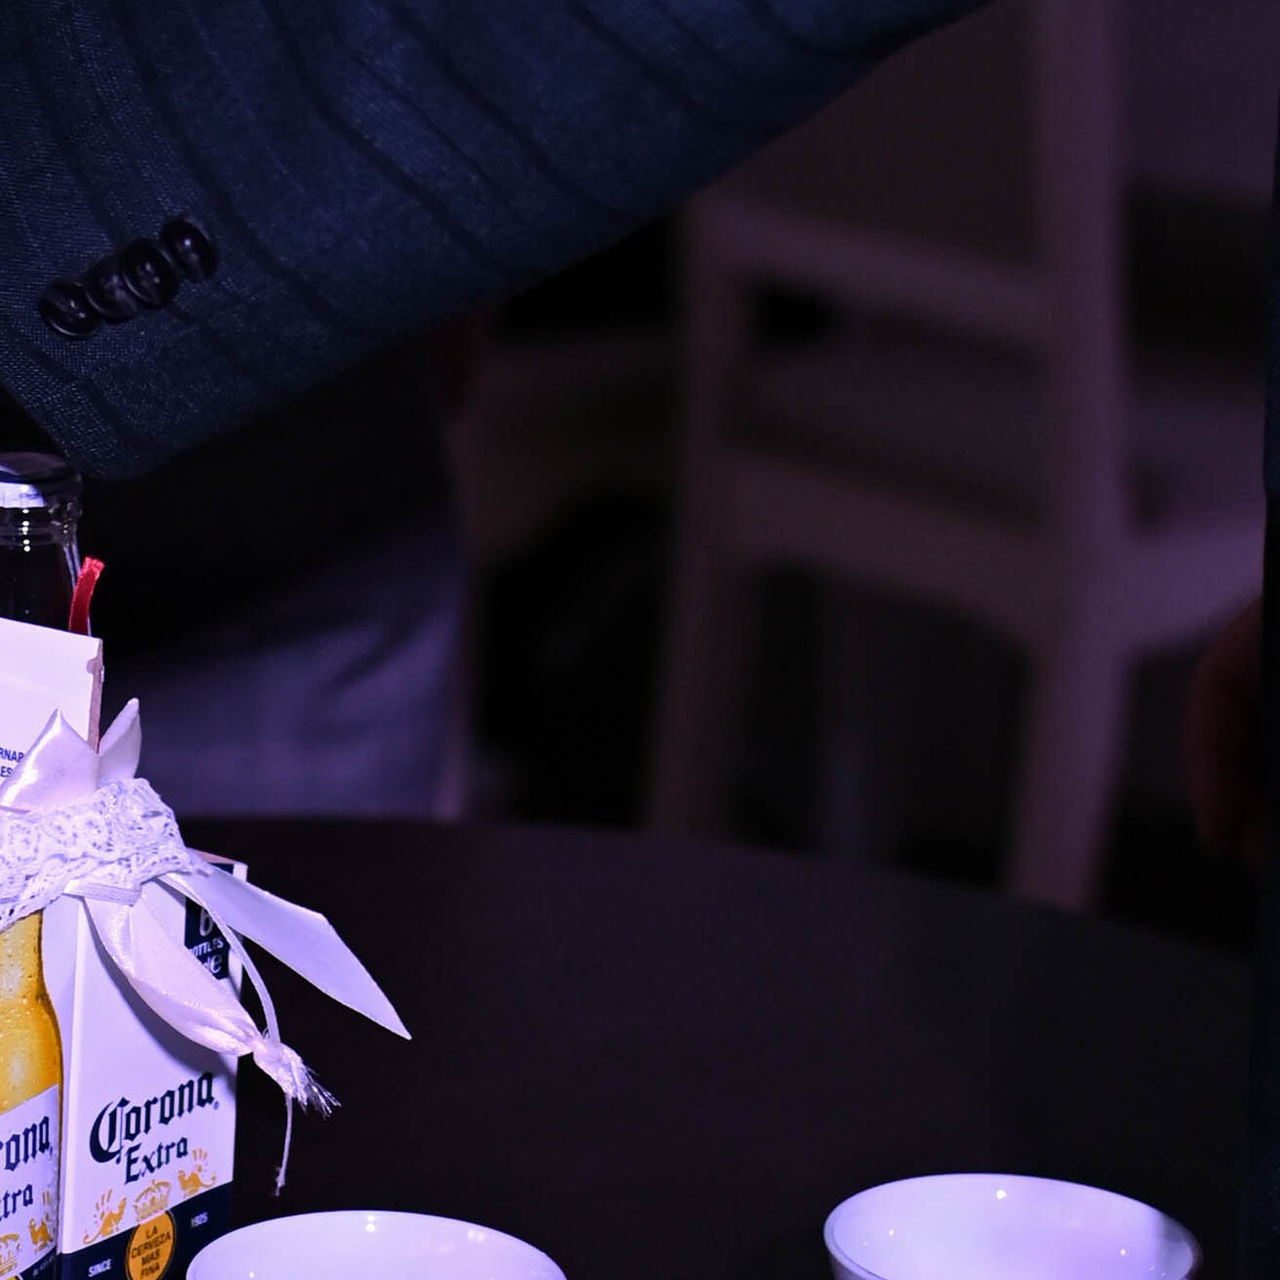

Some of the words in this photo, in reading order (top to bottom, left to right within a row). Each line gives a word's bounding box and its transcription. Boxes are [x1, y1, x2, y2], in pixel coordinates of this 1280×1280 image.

[89, 1072, 215, 1165] Corona
[125, 1137, 188, 1186] Extra
[146, 1225, 158, 1239] LA
[131, 1232, 171, 1259] CERVEZA
[88, 1258, 112, 1278] SINCE
[141, 1249, 161, 1267] MAS
